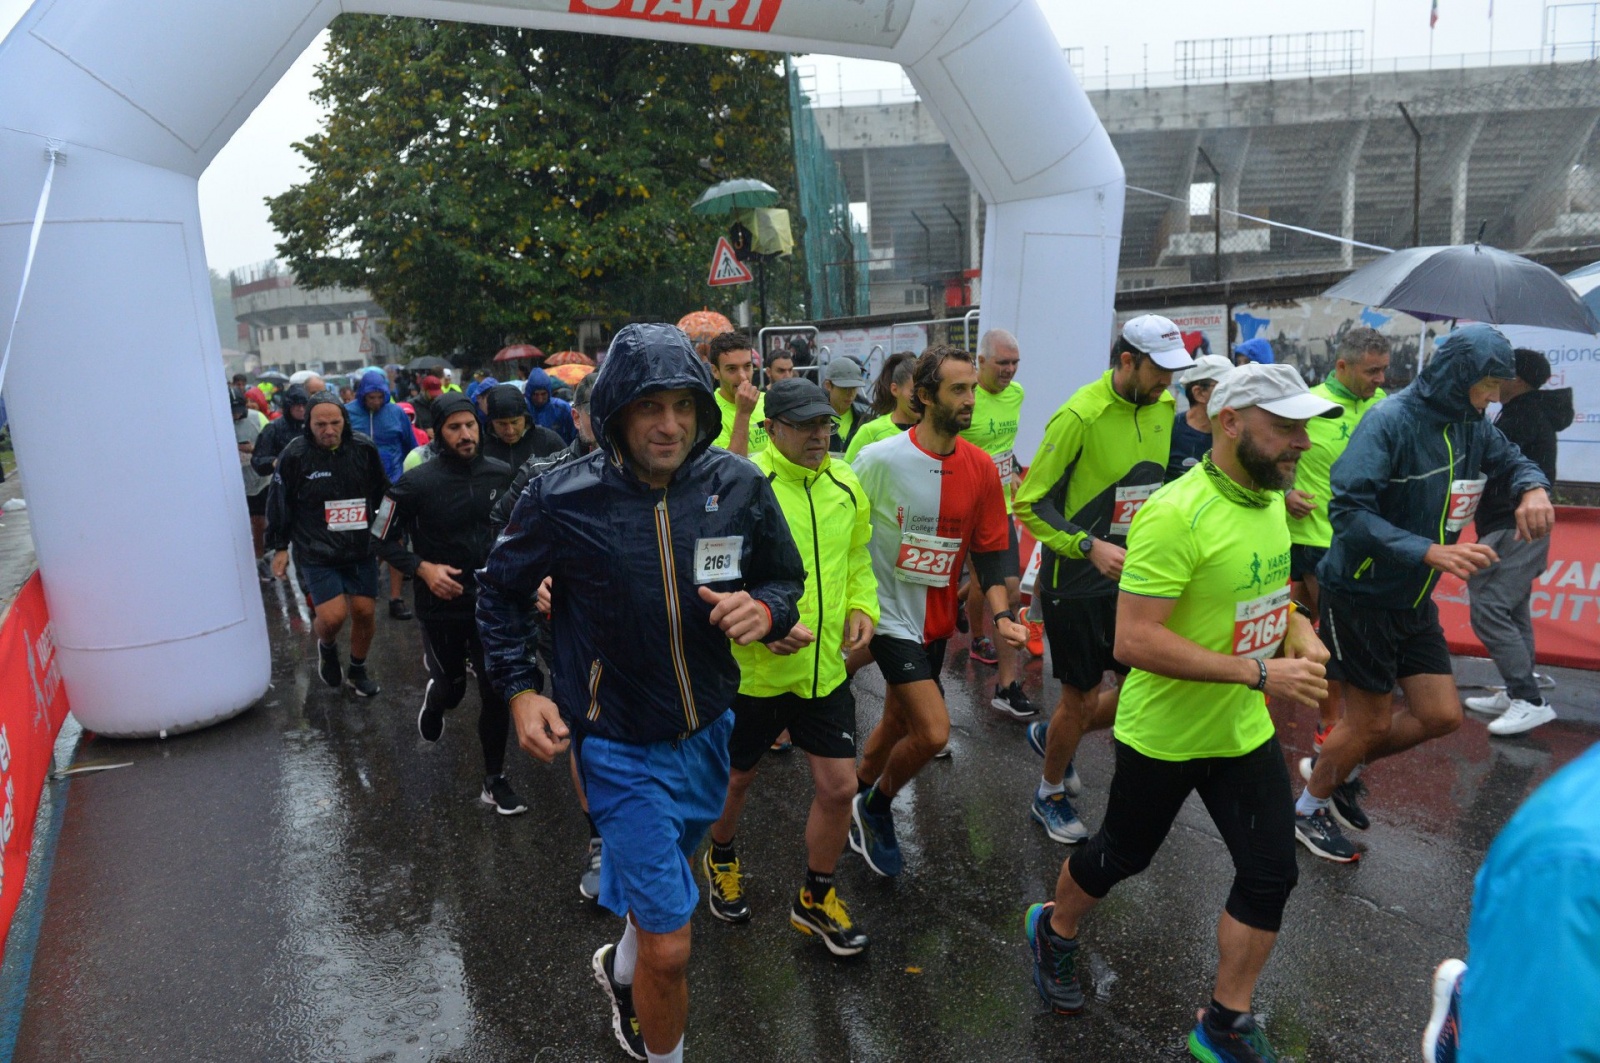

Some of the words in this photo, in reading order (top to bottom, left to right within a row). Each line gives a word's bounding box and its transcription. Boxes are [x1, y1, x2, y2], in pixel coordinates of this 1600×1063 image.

[581, 0, 764, 25] ART
[328, 507, 366, 523] 2367
[703, 553, 731, 571] 2163
[901, 547, 956, 574] 2231
[1530, 591, 1600, 624] CIT
[1236, 608, 1288, 653] 2164
